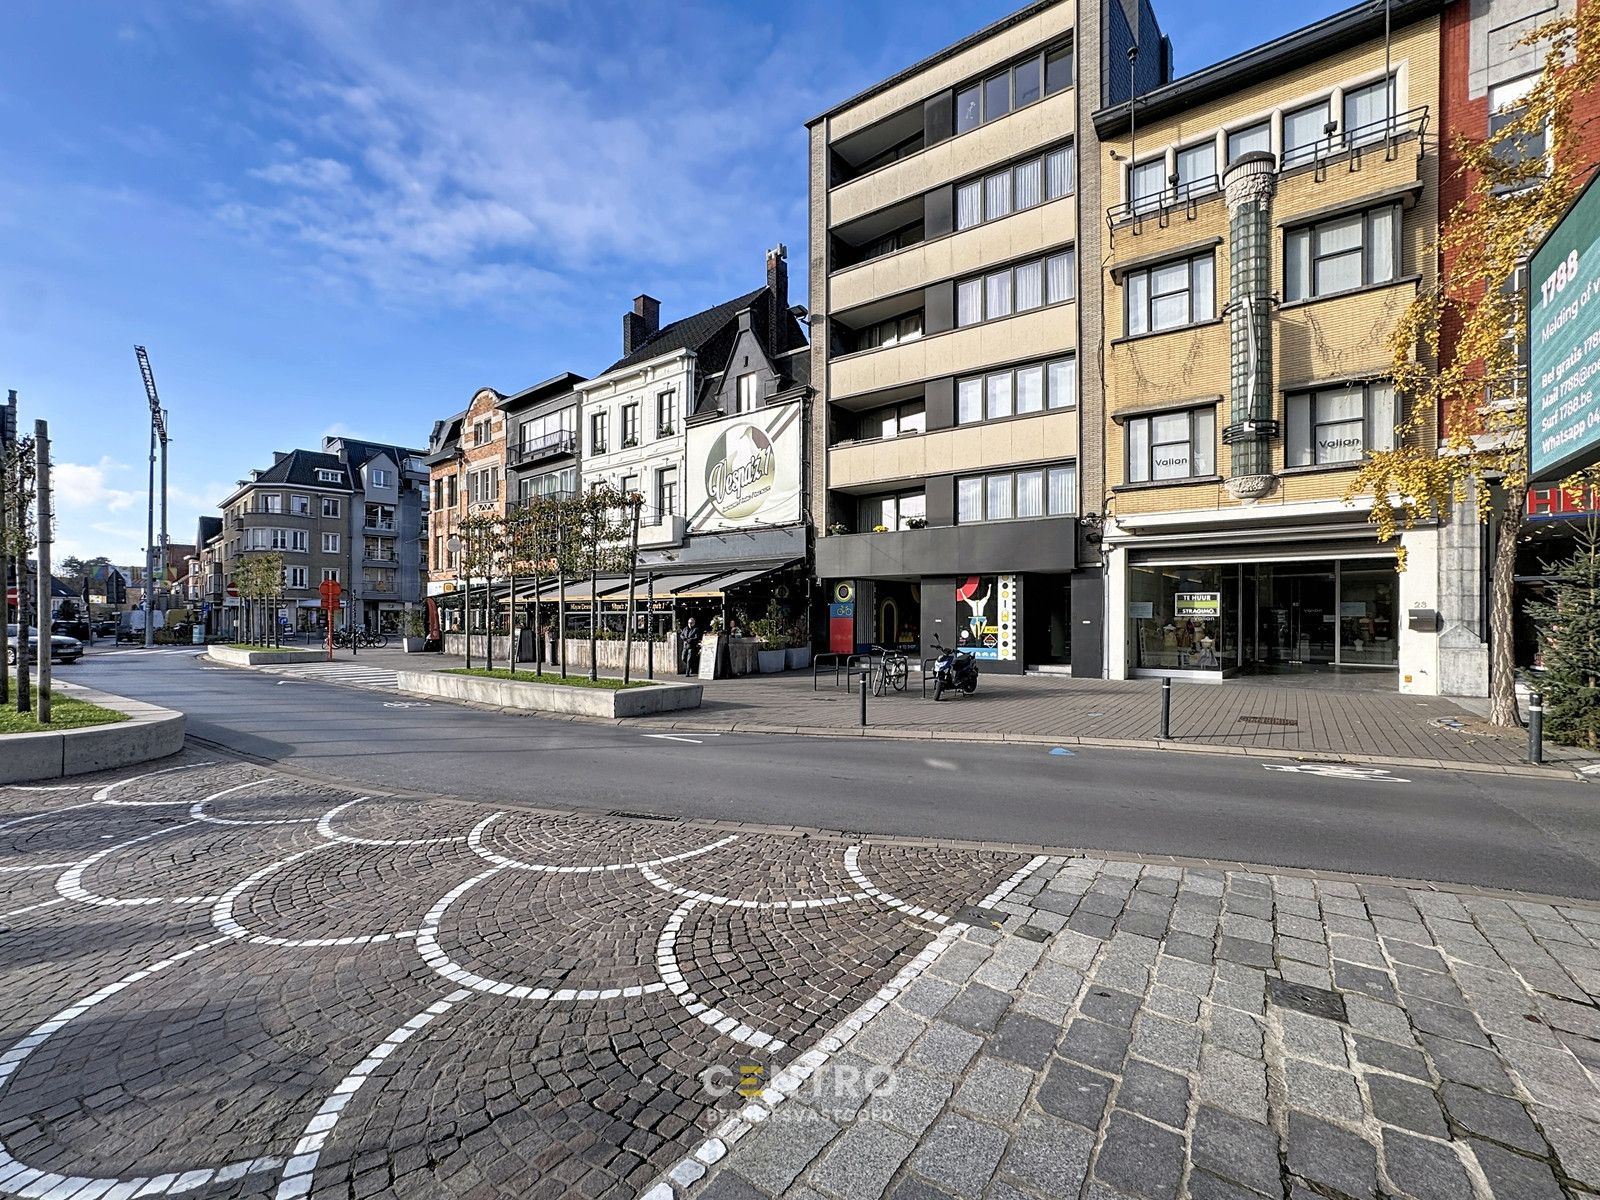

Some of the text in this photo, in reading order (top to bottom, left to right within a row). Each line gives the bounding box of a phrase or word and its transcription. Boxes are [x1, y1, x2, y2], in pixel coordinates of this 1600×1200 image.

[1541, 249, 1578, 308] 1788
[1541, 300, 1578, 344] Melding
[1580, 281, 1592, 306] of
[1541, 331, 1600, 388] Bel gratis 178
[1541, 386, 1559, 411] Mail
[1541, 390, 1593, 432] Surf 1788.be
[1541, 420, 1585, 454] Whatsapp
